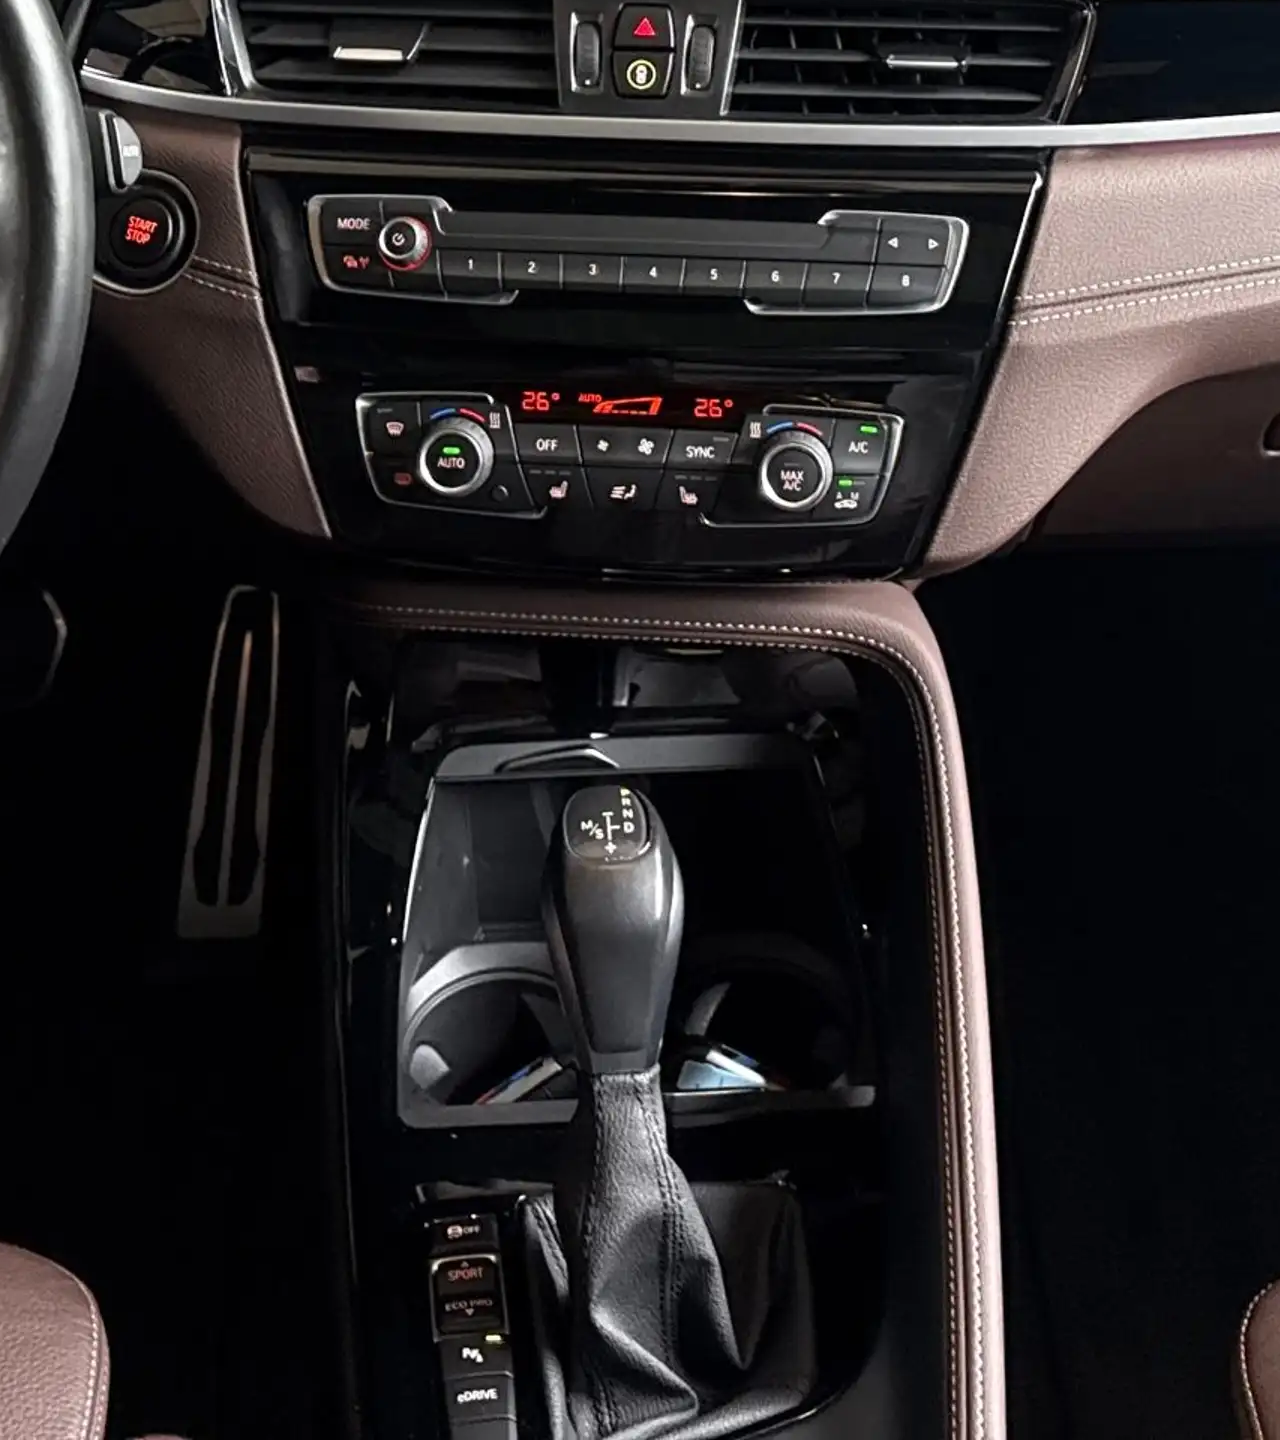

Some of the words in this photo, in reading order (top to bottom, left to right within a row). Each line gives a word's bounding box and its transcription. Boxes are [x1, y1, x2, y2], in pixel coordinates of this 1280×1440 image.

[128, 215, 158, 234] START
[336, 217, 370, 230] MODE
[125, 227, 151, 244] STOP
[467, 258, 475, 271] 1
[527, 261, 537, 275] 2
[588, 263, 598, 276] 3
[648, 266, 658, 279] 4
[710, 268, 719, 281] 5
[770, 270, 780, 283] 6
[832, 272, 841, 285] 7
[900, 274, 910, 287] 8
[578, 392, 602, 403] AUTO
[535, 437, 559, 452] OFF
[848, 441, 869, 454] A/C
[685, 445, 715, 459] SYNC
[436, 456, 466, 469] AUTO
[780, 469, 804, 482] MAX
[782, 480, 803, 492] A/C
[622, 808, 634, 820] N
[623, 821, 636, 834] D
[447, 1266, 485, 1282] SPORT
[444, 1299, 468, 1312] ECO
[456, 1387, 499, 1404] eDRIVE
